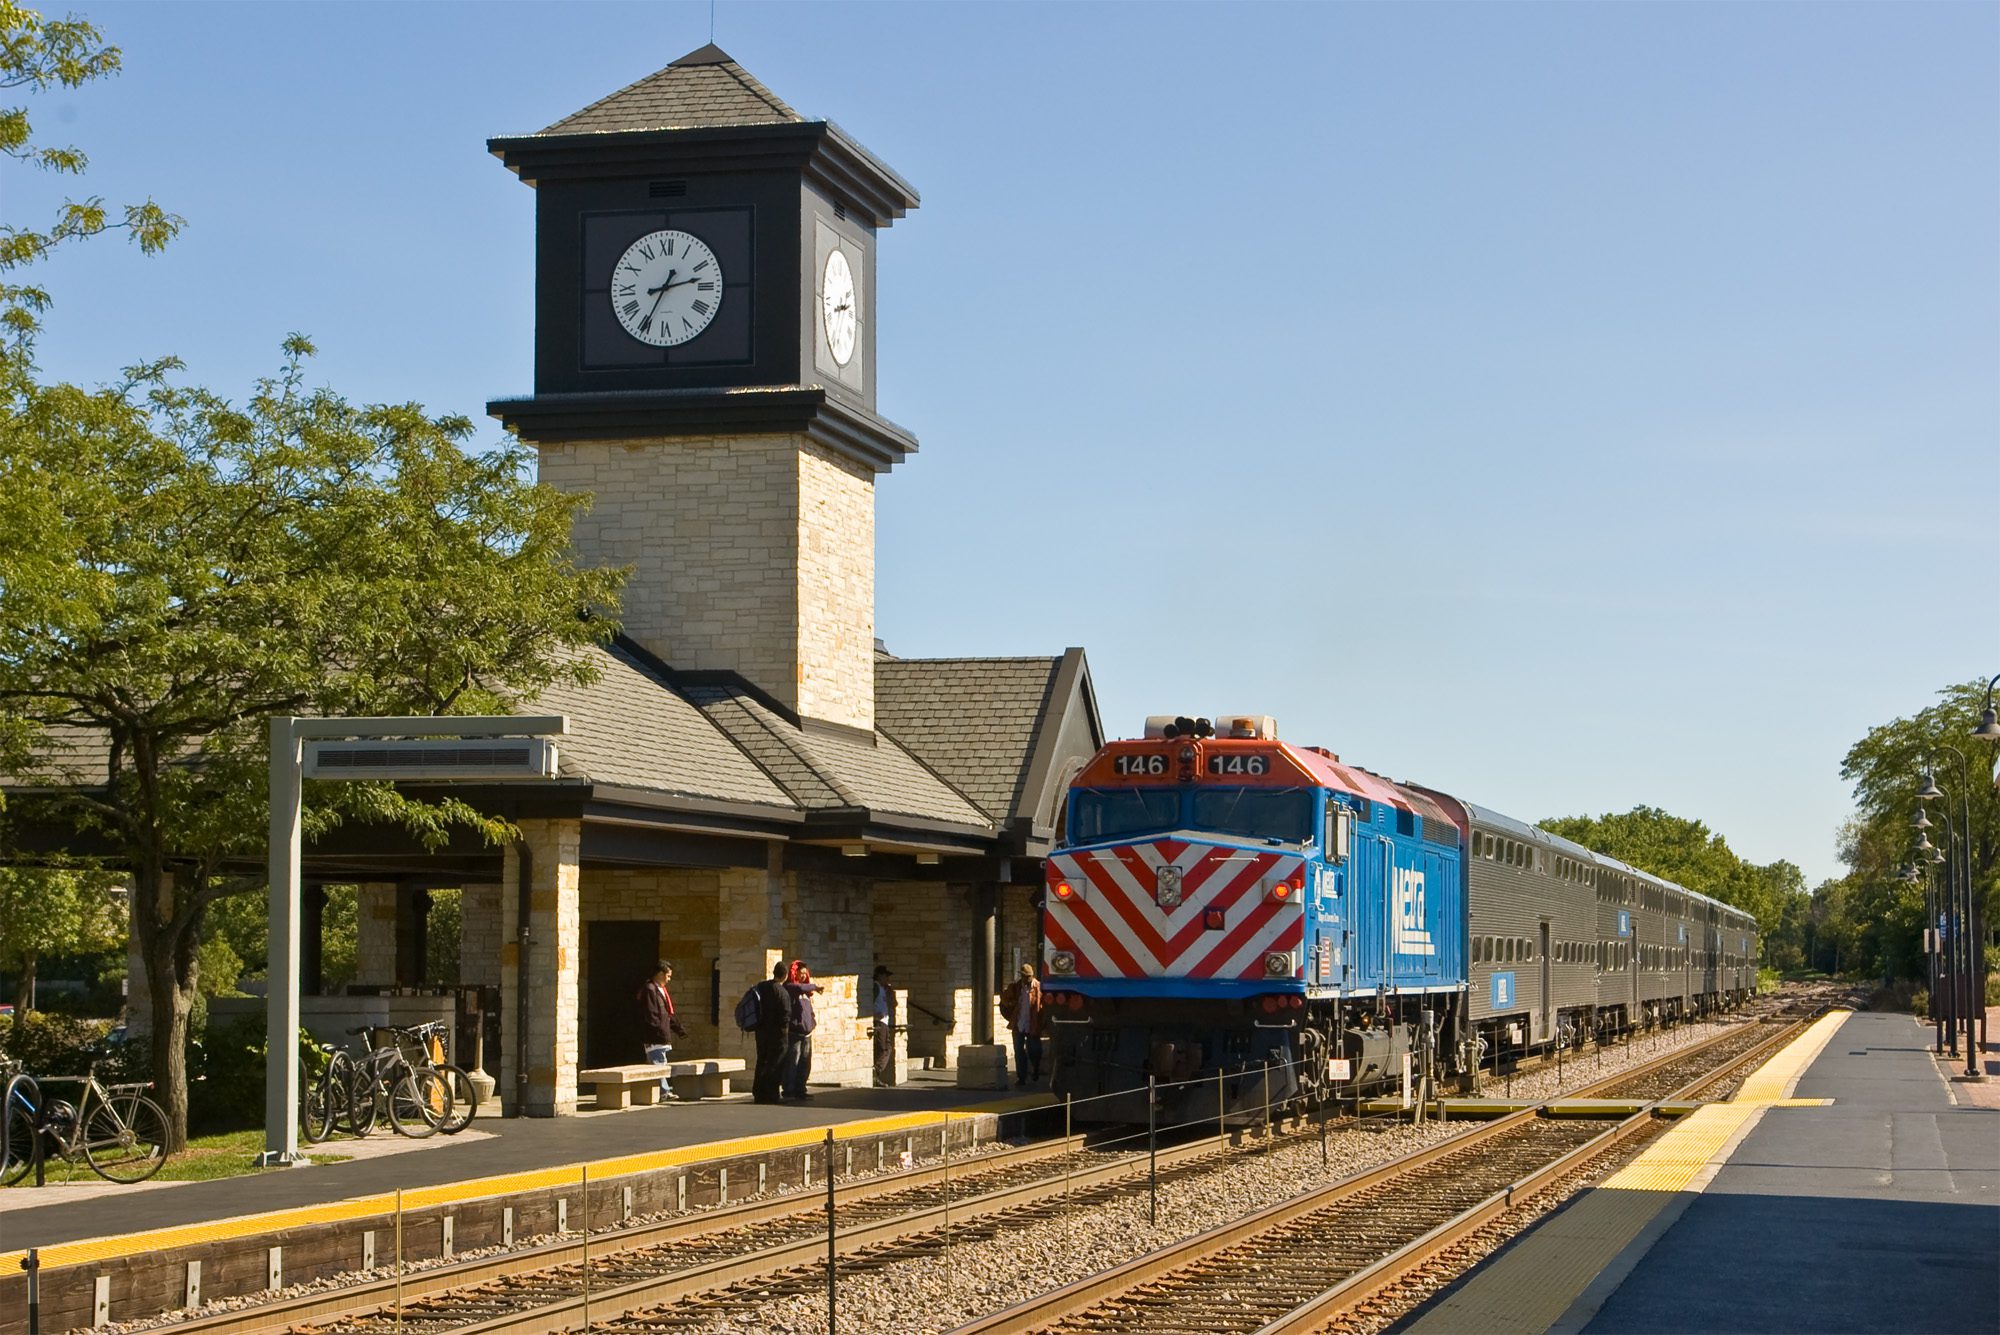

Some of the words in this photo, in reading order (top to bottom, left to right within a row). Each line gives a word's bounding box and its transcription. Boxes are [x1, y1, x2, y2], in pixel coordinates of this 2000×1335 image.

[639, 244, 655, 263] XI
[660, 239, 674, 256] XII
[682, 244, 691, 259] I
[624, 262, 641, 276] X
[693, 260, 708, 272] II
[619, 284, 636, 296] IX
[698, 282, 714, 291] III
[622, 300, 640, 321] VIII
[661, 321, 671, 337] VI
[682, 316, 692, 332] V
[1118, 755, 1163, 775] 146
[1213, 755, 1263, 775] 146
[1393, 860, 1435, 955] Metra
